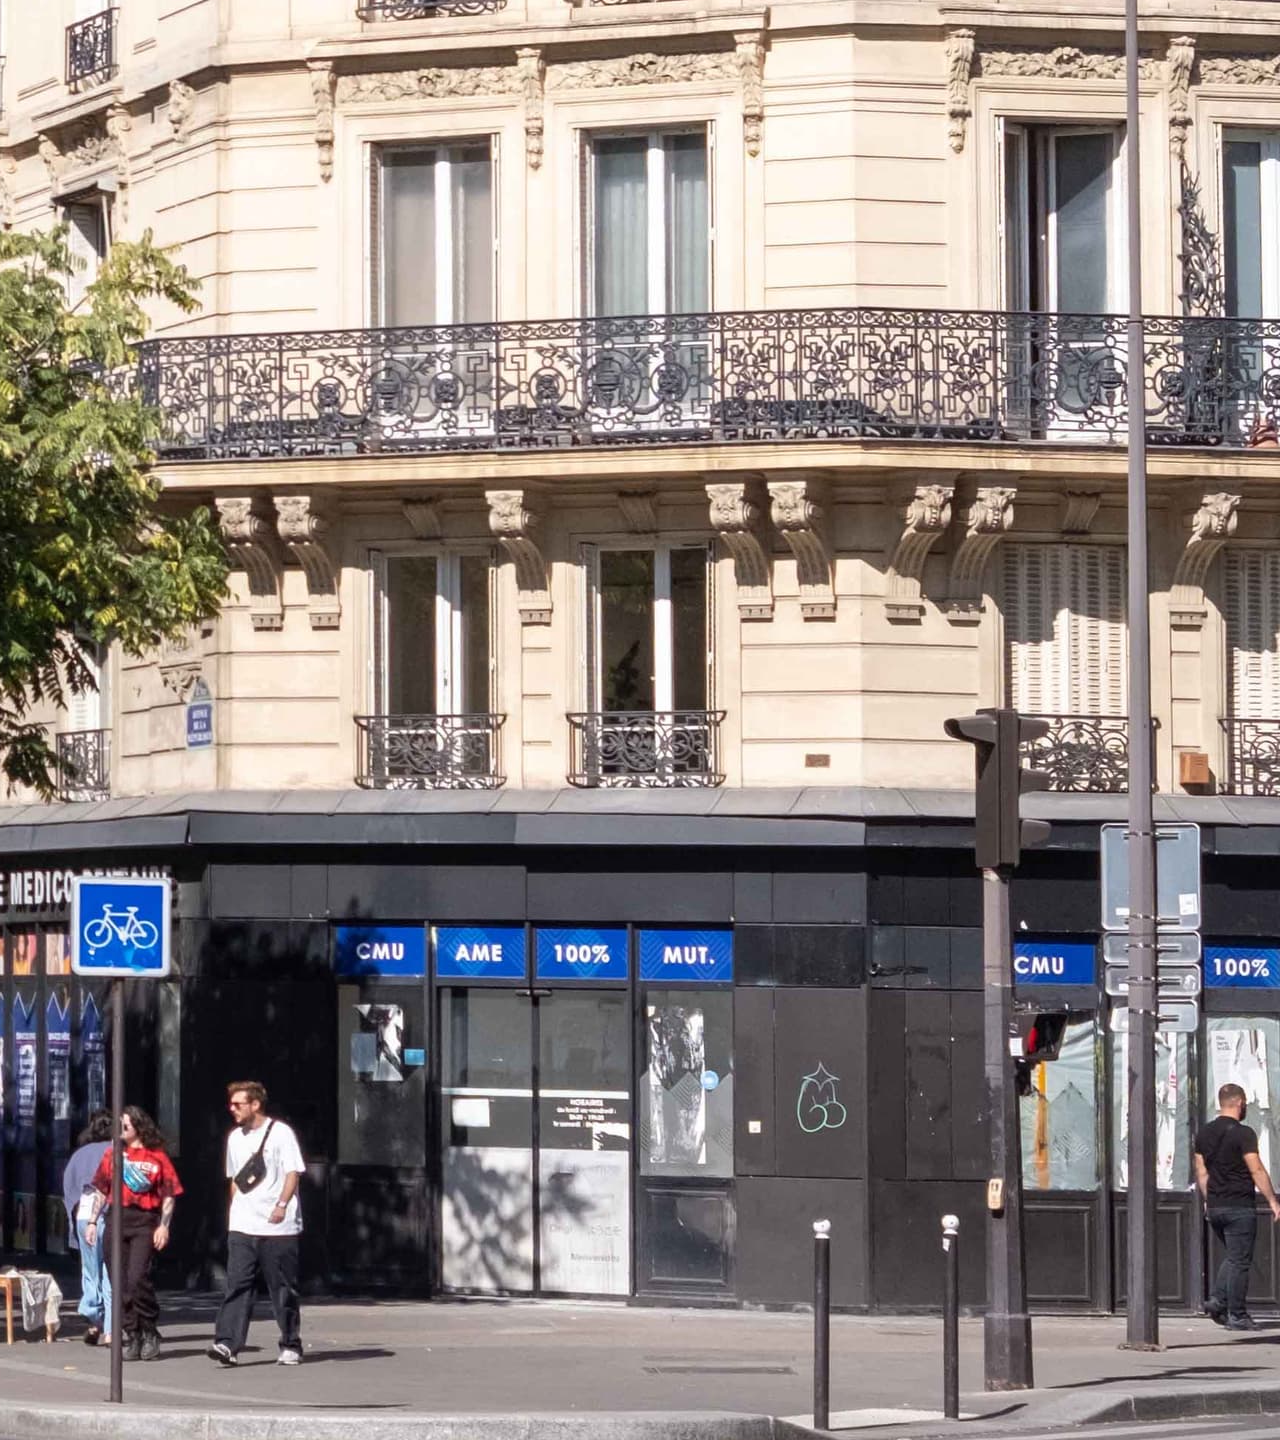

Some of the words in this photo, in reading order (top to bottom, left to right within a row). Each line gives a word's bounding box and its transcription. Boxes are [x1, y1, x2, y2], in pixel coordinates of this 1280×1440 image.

[10, 869, 74, 907] MEDICO
[356, 942, 405, 961] CMU
[454, 943, 504, 963] AME
[553, 944, 611, 964] 100%
[662, 945, 716, 965] MUT.
[1013, 956, 1065, 975] CMU
[1212, 957, 1270, 978] 100%
